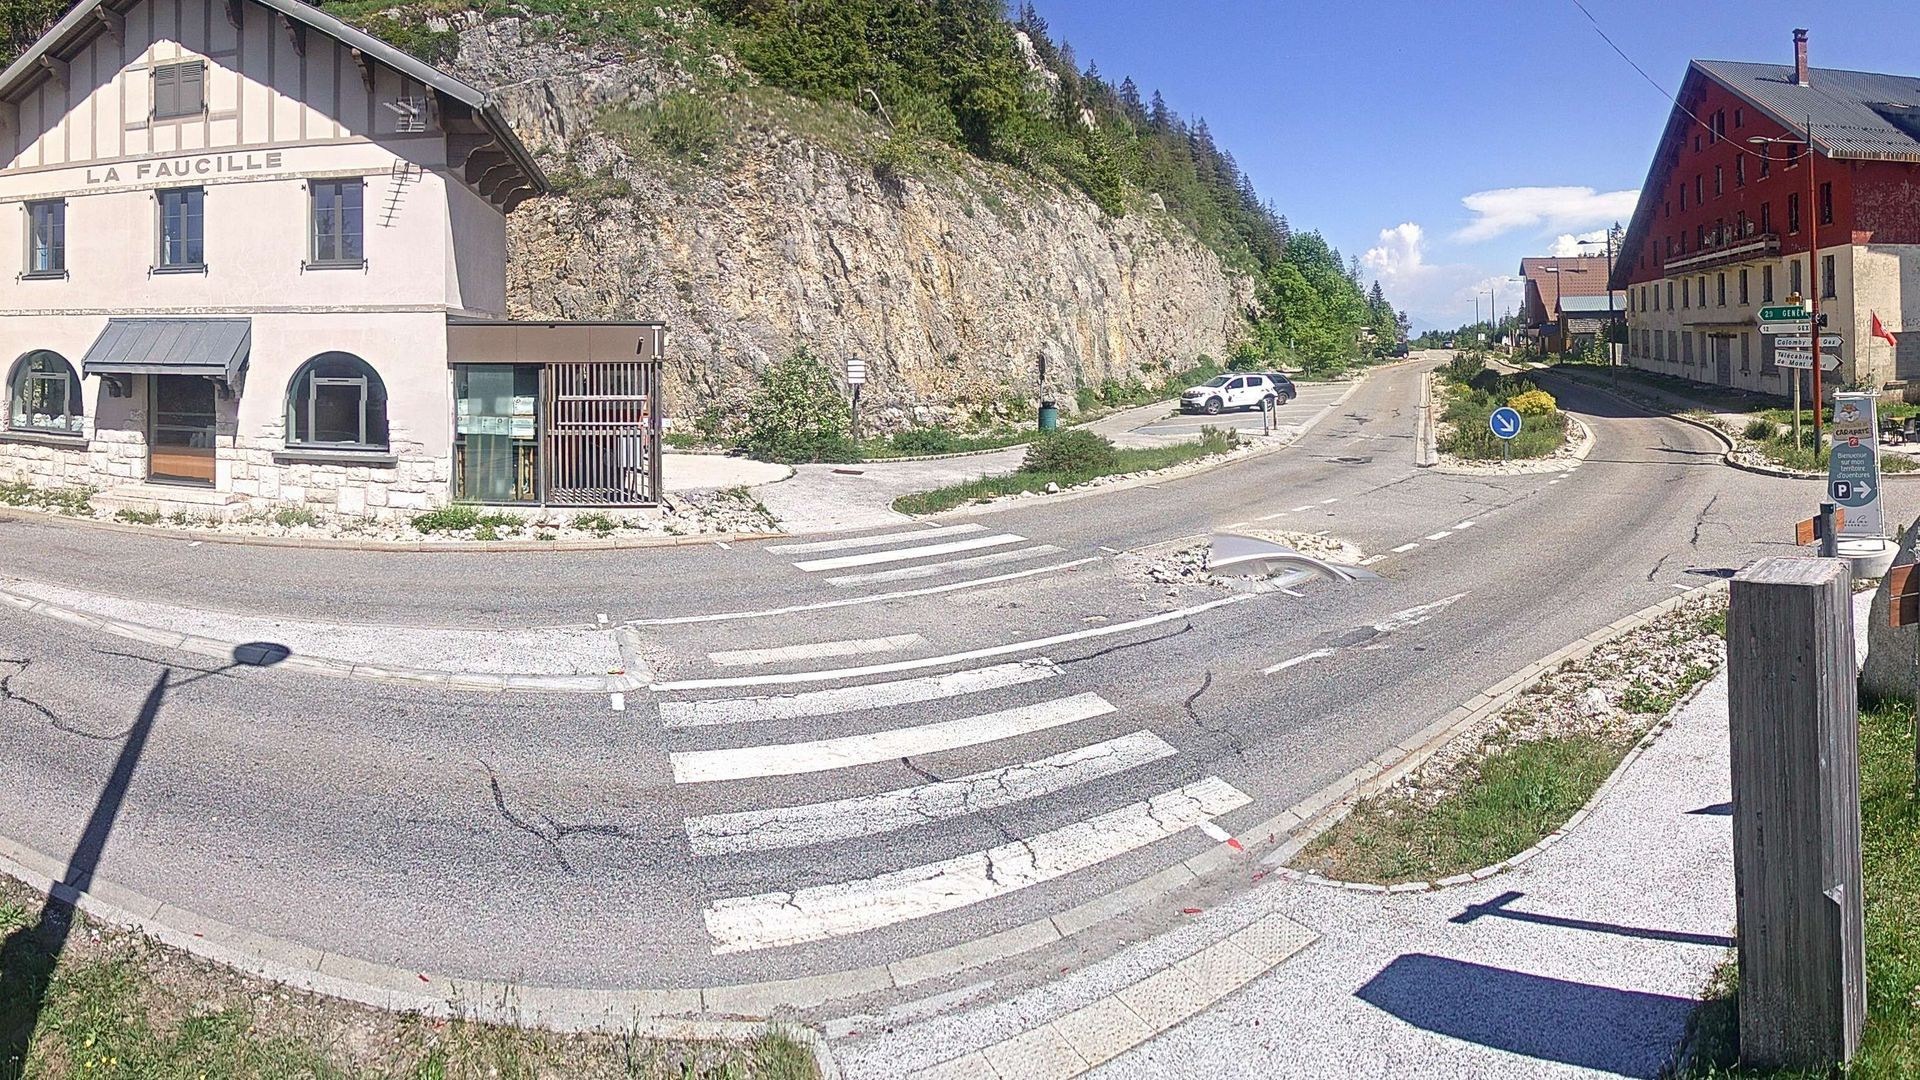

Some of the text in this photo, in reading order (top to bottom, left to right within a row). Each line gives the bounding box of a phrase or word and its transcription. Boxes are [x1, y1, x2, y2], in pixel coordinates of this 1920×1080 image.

[86, 152, 282, 185] LA FAUCILLE
[1838, 484, 1847, 497] P
